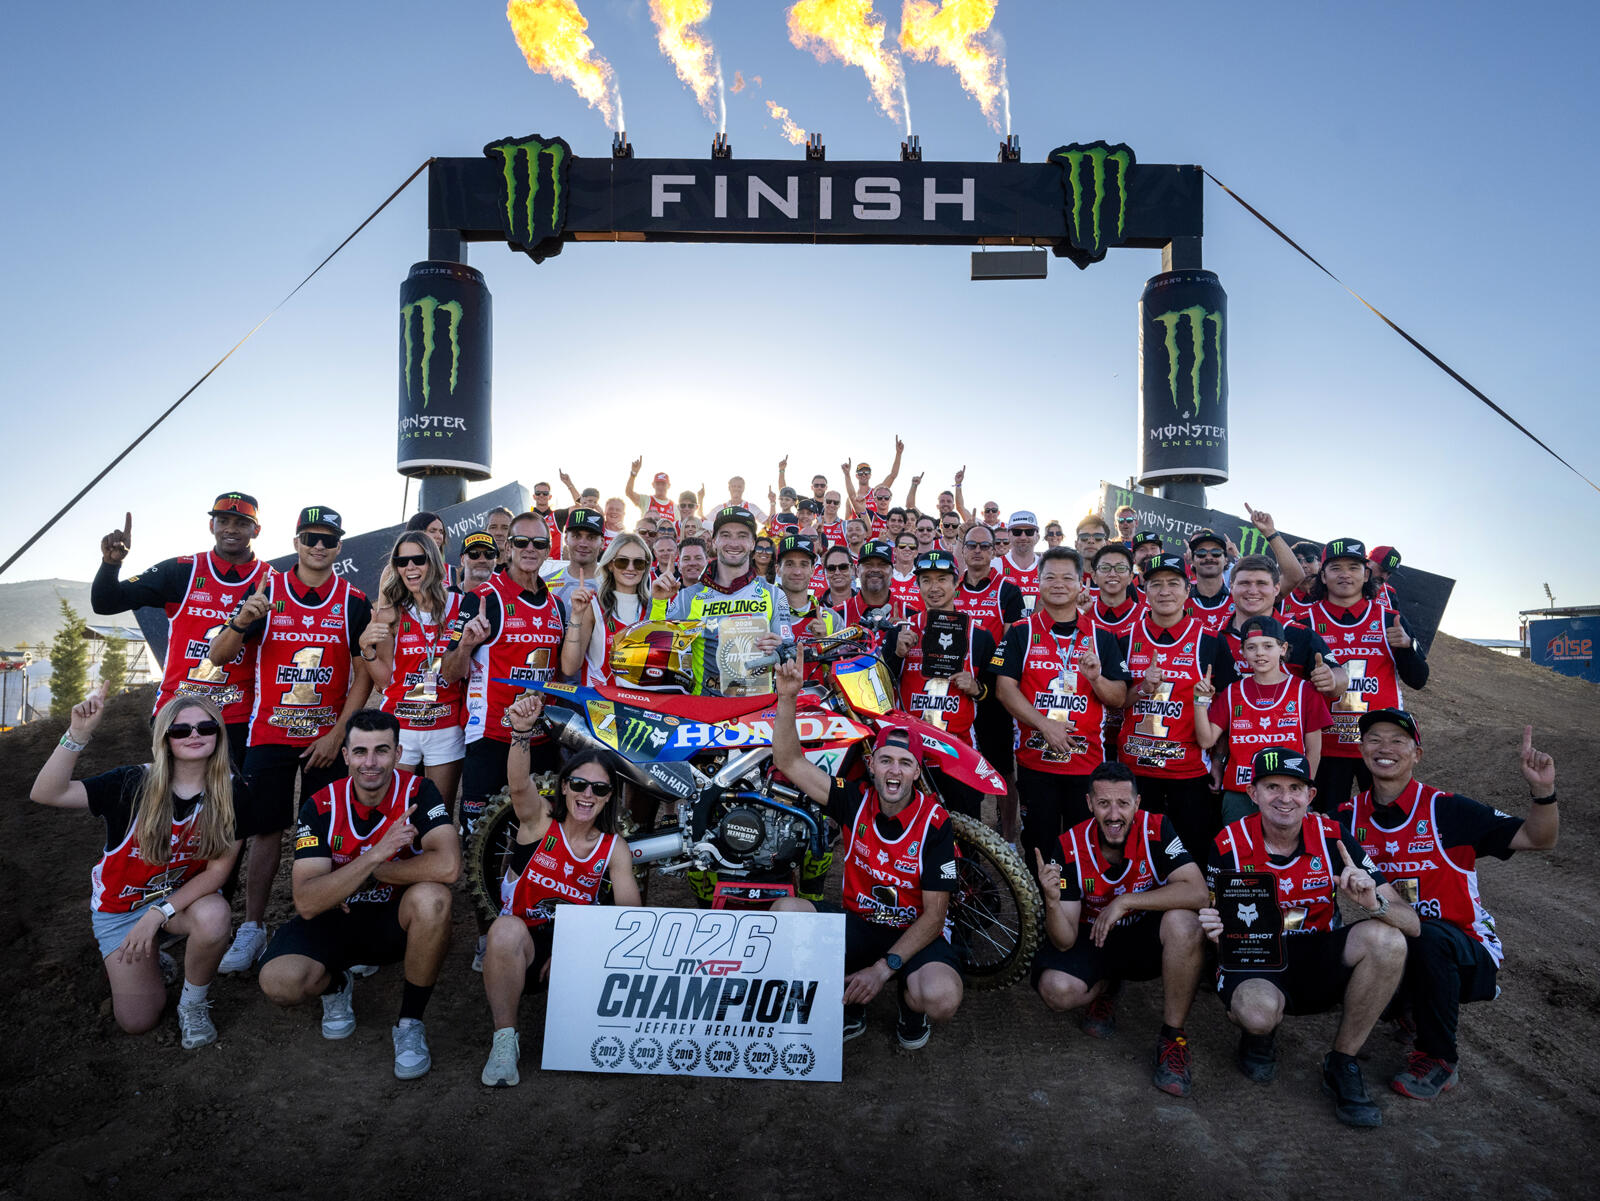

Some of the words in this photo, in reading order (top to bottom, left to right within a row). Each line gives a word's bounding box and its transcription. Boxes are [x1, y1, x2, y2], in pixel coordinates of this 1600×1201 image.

[651, 174, 976, 222] FINISH
[401, 431, 454, 440] ENERGY
[1150, 422, 1226, 441] MONSTER
[1162, 440, 1220, 448] ENERGY
[702, 600, 767, 616] HERLINGS
[272, 632, 341, 643] HONDA
[505, 634, 560, 643] HONDA
[1331, 647, 1384, 656] ONDA
[276, 665, 333, 684] HERLINGS
[280, 646, 325, 706] 1
[547, 682, 575, 692] PIRELLI
[617, 693, 650, 702] HONDA
[911, 693, 959, 713] HERLINGS
[1035, 692, 1088, 713] HERLINGS
[273, 707, 305, 716] WORLD
[1133, 700, 1182, 719] HERLINGS
[1135, 682, 1175, 738] 1
[268, 714, 337, 727] CHAMPION
[597, 713, 616, 732] 1
[287, 727, 318, 737] 2026
[1232, 733, 1297, 744] HONDA
[1339, 734, 1361, 743] 202
[1124, 744, 1186, 758] CHAMPION
[650, 765, 667, 783] Satu
[727, 824, 759, 834] HONDA
[727, 830, 756, 839] HINSON
[1408, 841, 1434, 853] HRC
[535, 855, 558, 870] SPRINTA
[1377, 860, 1439, 873] ONDA
[854, 856, 914, 889] HONDA
[527, 868, 592, 901] HONDA
[1302, 876, 1329, 890] HRC
[748, 889, 760, 899] 84
[604, 910, 777, 974] 2026
[674, 959, 742, 976] MXGP
[597, 973, 818, 1025] CHAMPION
[635, 1021, 696, 1035] JEFFREY
[705, 1025, 775, 1038] HERLINGS
[599, 1045, 617, 1057] 2012
[637, 1047, 656, 1059] 2013
[674, 1049, 694, 1060] 2016
[713, 1050, 732, 1062] 2018
[752, 1051, 771, 1063] 2021
[787, 1053, 807, 1065] 2026
